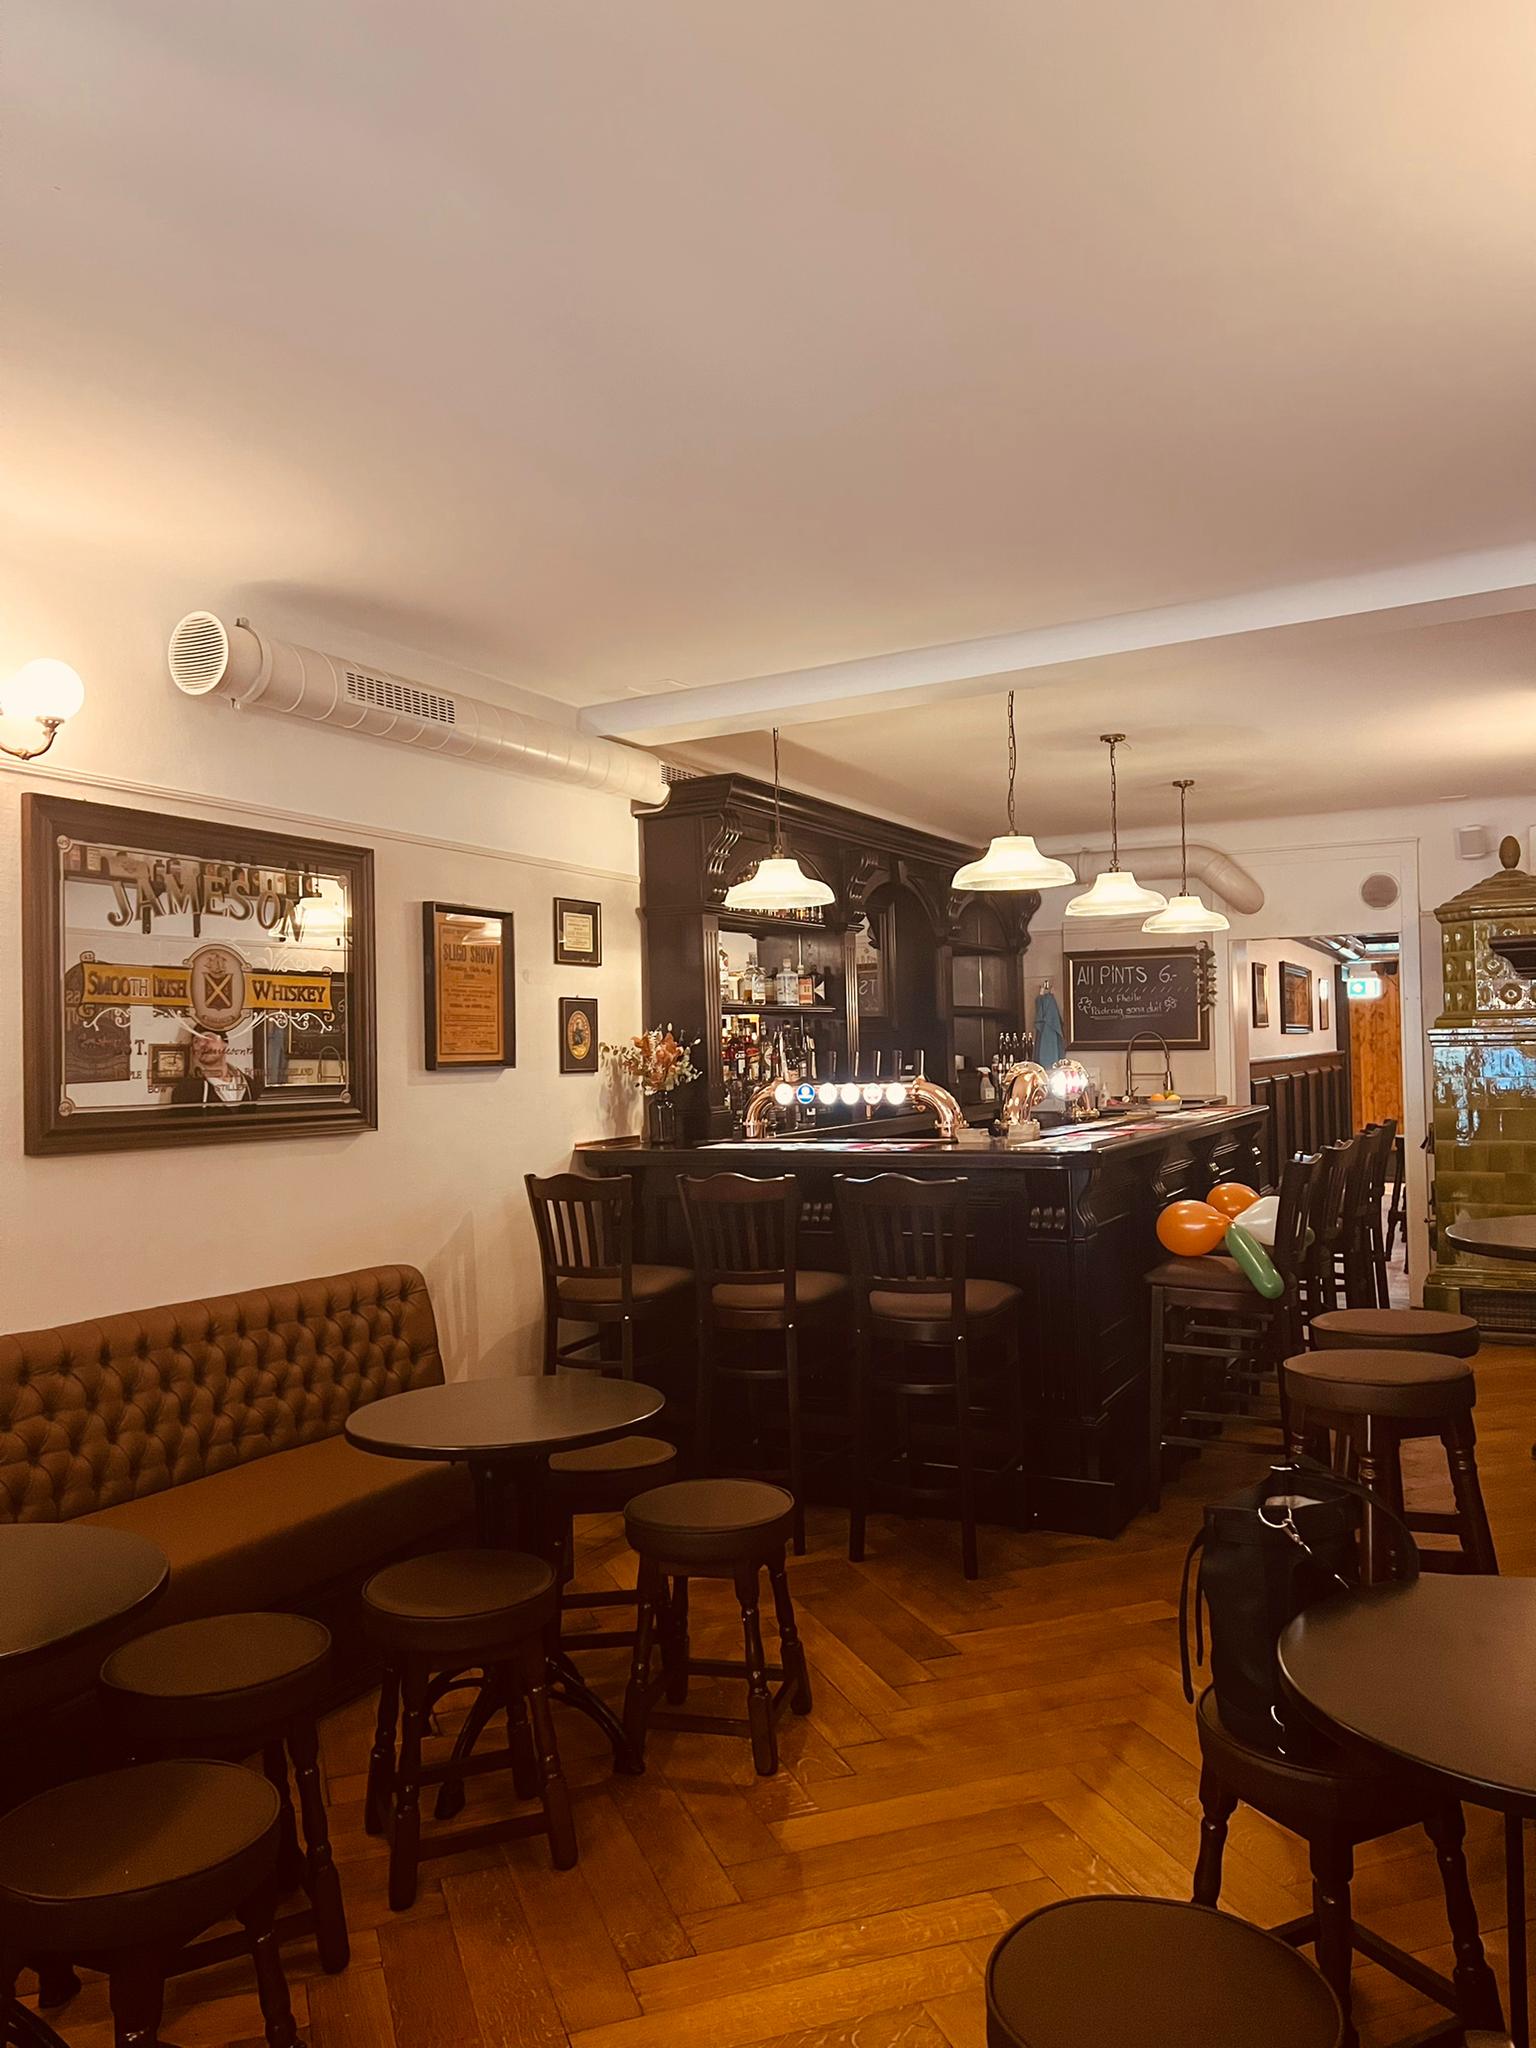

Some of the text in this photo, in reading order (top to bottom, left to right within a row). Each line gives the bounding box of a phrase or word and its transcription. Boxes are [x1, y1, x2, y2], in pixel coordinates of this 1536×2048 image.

[106, 868, 308, 943] JAMESON
[1077, 965, 1094, 986] All
[251, 979, 327, 1003] WHISKEY
